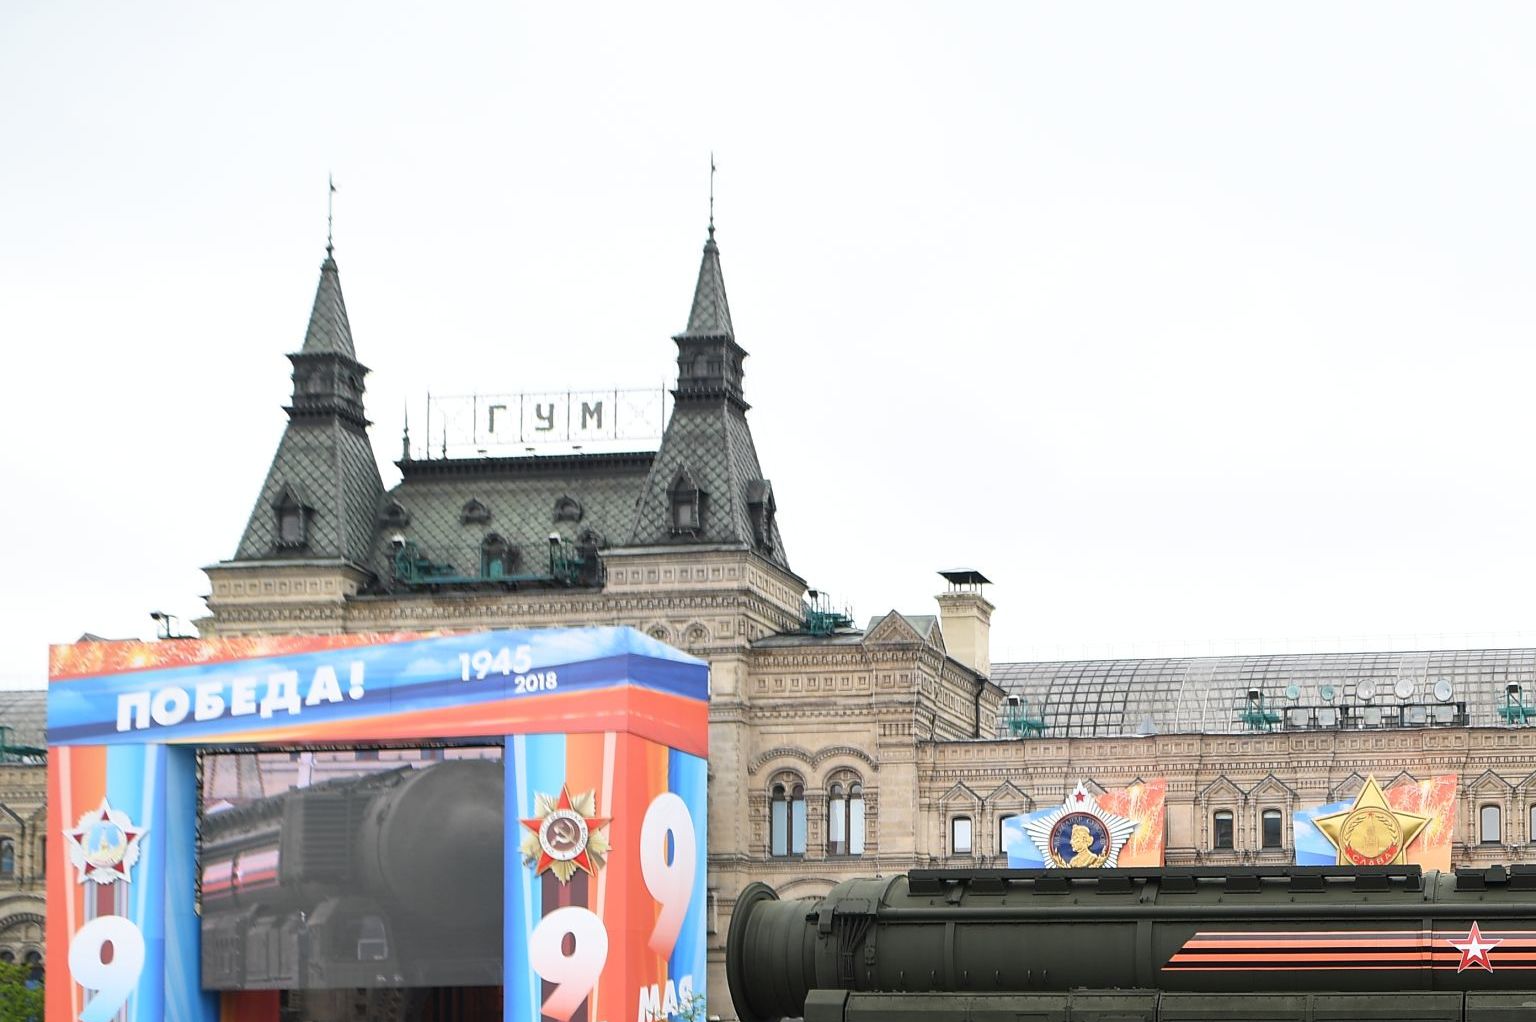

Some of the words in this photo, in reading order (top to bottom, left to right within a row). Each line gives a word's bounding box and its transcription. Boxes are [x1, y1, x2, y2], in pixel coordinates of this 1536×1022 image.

[487, 400, 603, 433] ГУМ
[459, 644, 532, 681] 1945
[514, 671, 558, 694] 2018
[116, 660, 365, 732] ПОБЕДА!
[640, 792, 696, 962] 9
[529, 906, 608, 1022] 9
